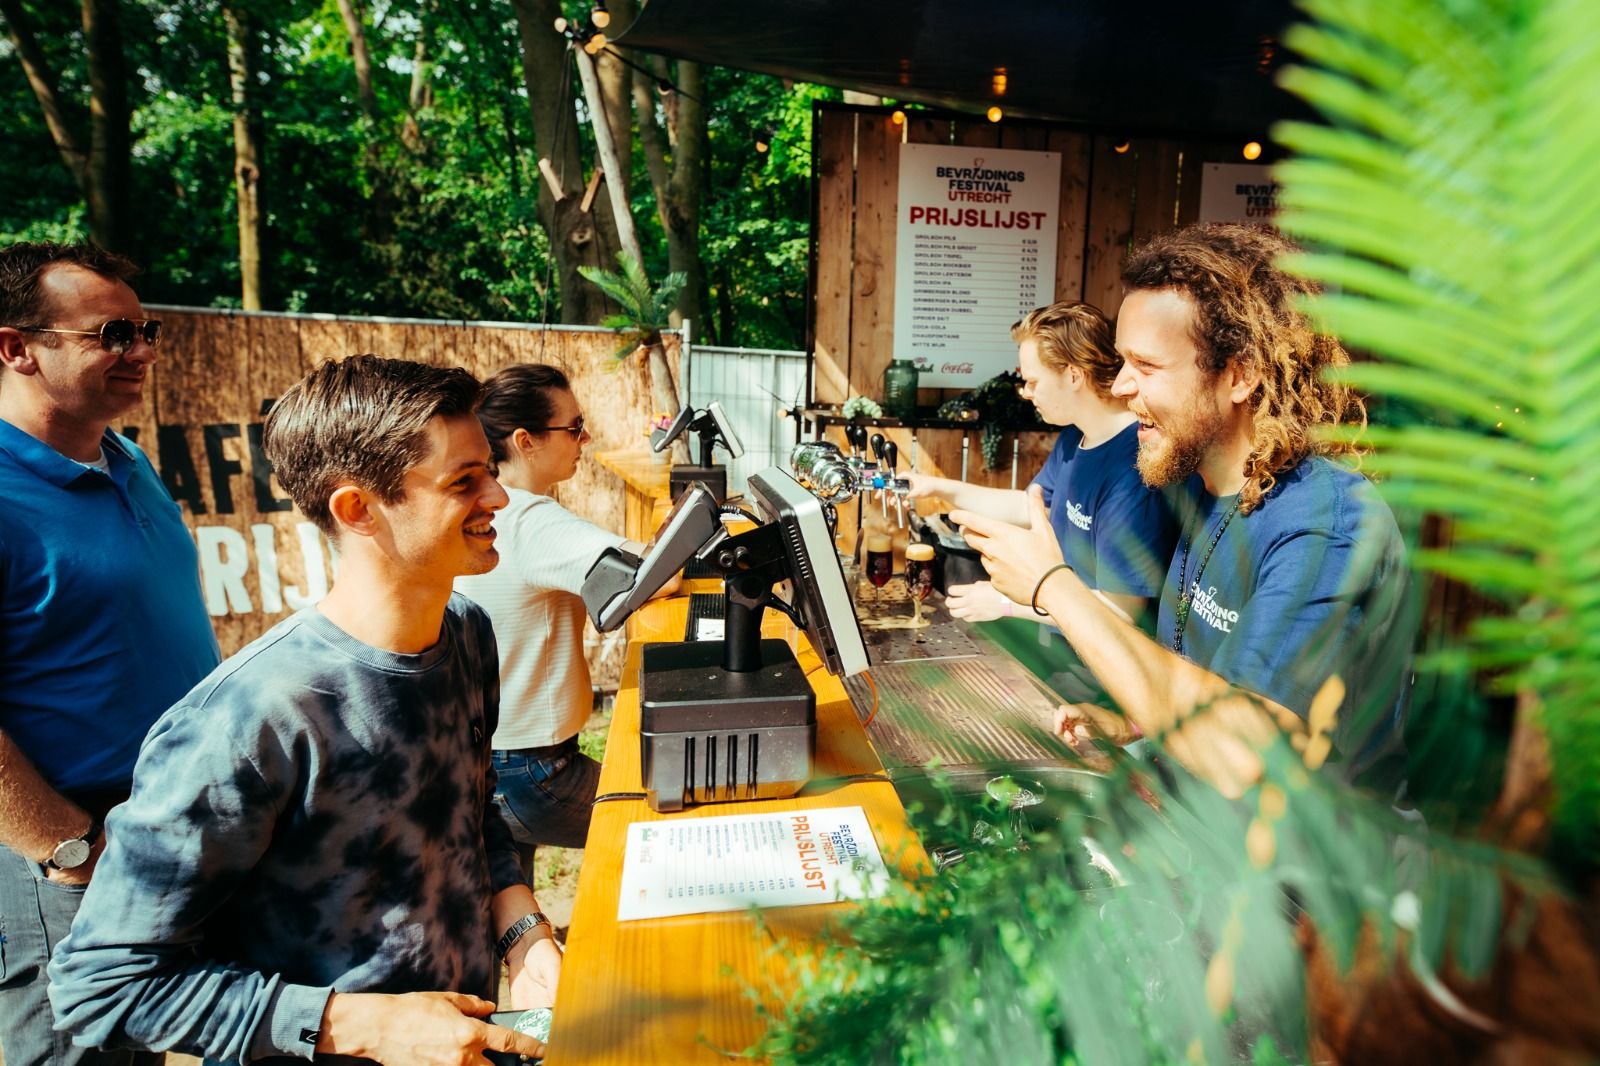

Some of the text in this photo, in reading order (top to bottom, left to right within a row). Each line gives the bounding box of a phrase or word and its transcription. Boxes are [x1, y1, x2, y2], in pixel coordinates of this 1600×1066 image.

[936, 167, 1024, 182] BEVRIJDINGS
[949, 180, 1011, 193] FESTIVAL
[948, 191, 1012, 204] UTRECHT
[909, 206, 1047, 230] PRIJSLIJST
[122, 398, 293, 516] AFÉ
[188, 521, 341, 617] RIJ
[790, 815, 826, 891] PRIJSLIJST
